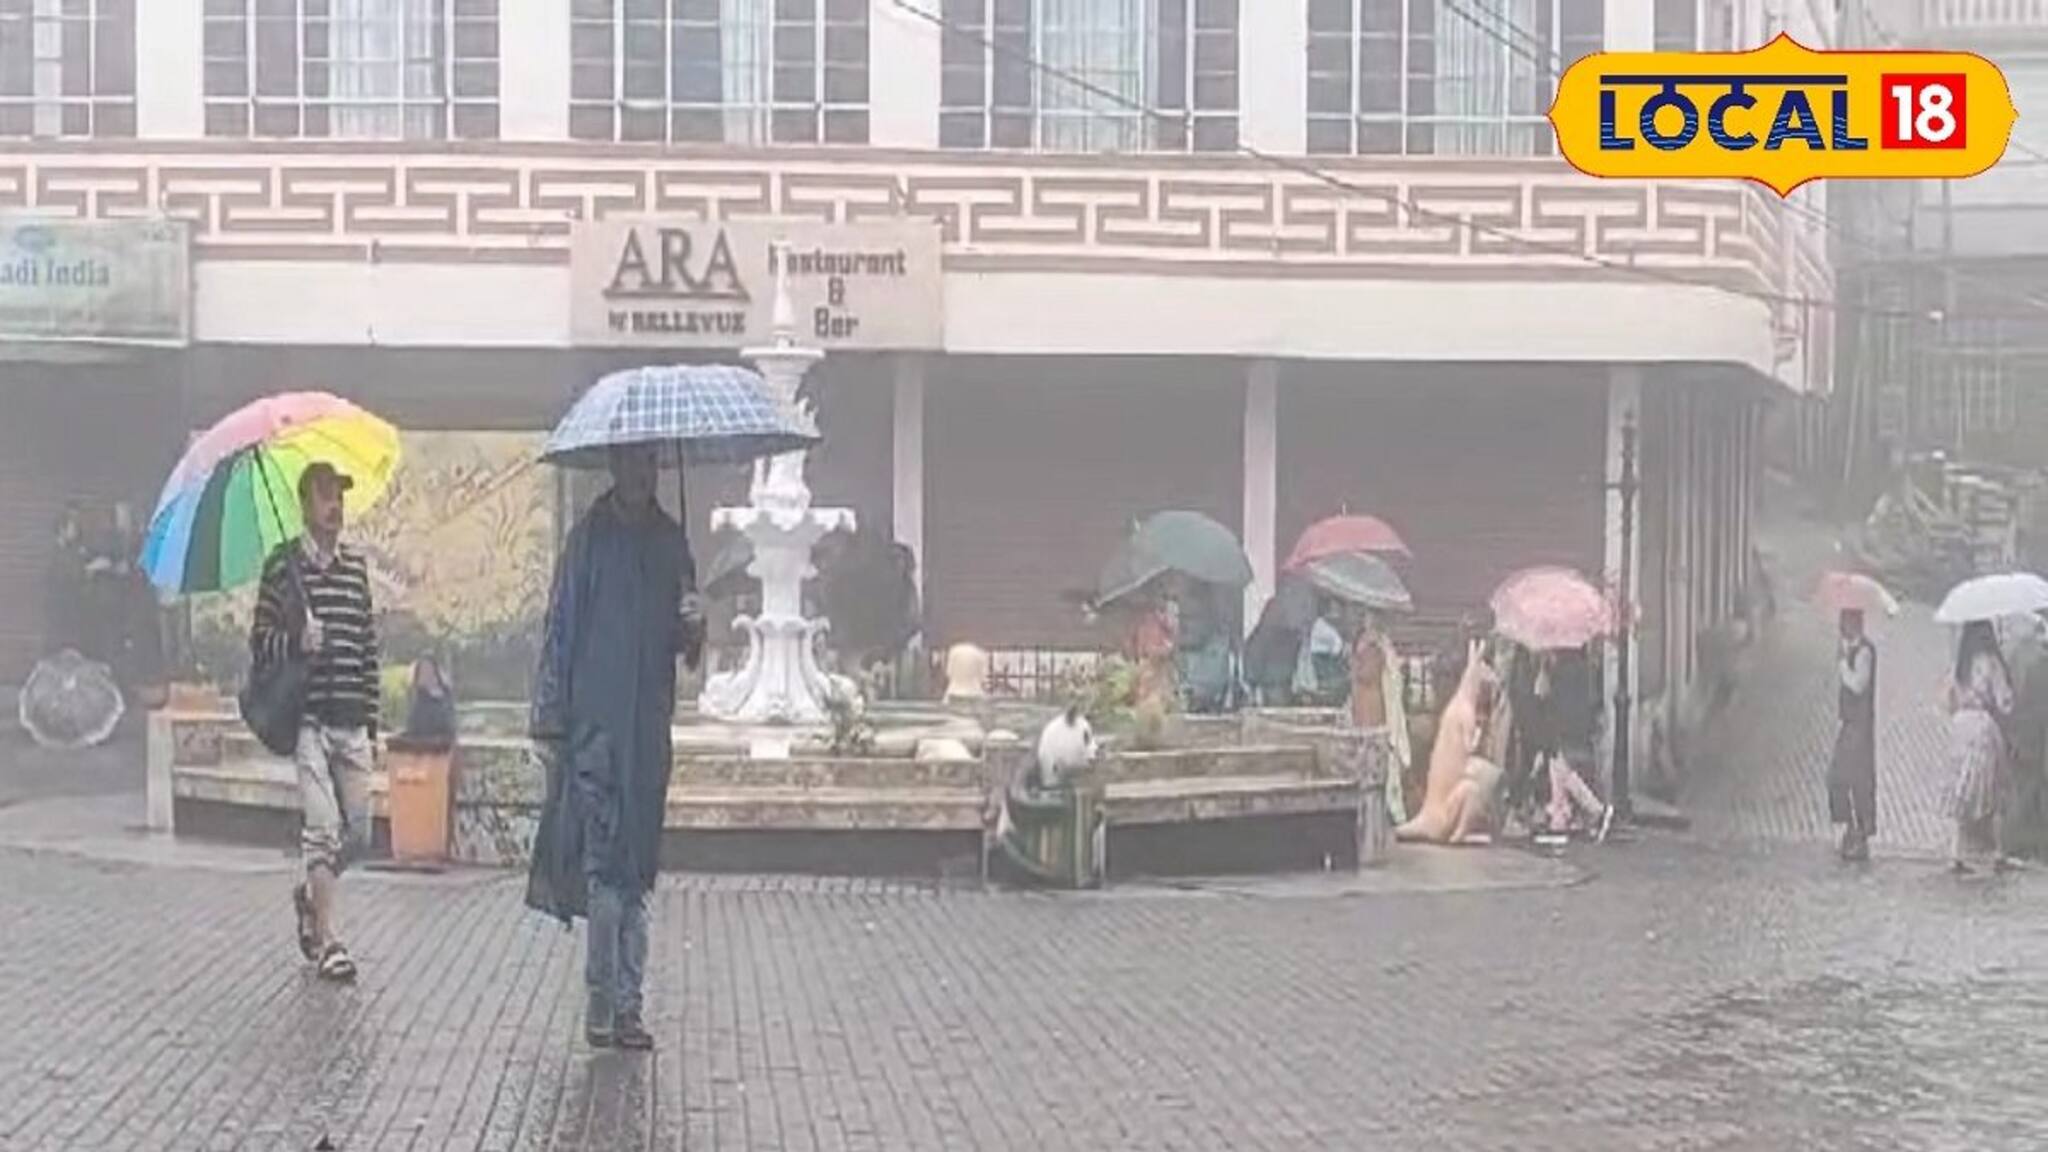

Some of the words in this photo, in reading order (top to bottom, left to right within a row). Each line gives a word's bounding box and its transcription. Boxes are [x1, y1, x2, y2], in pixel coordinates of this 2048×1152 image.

[46, 258, 111, 287] India
[606, 228, 750, 293] ARA
[828, 277, 845, 306] &
